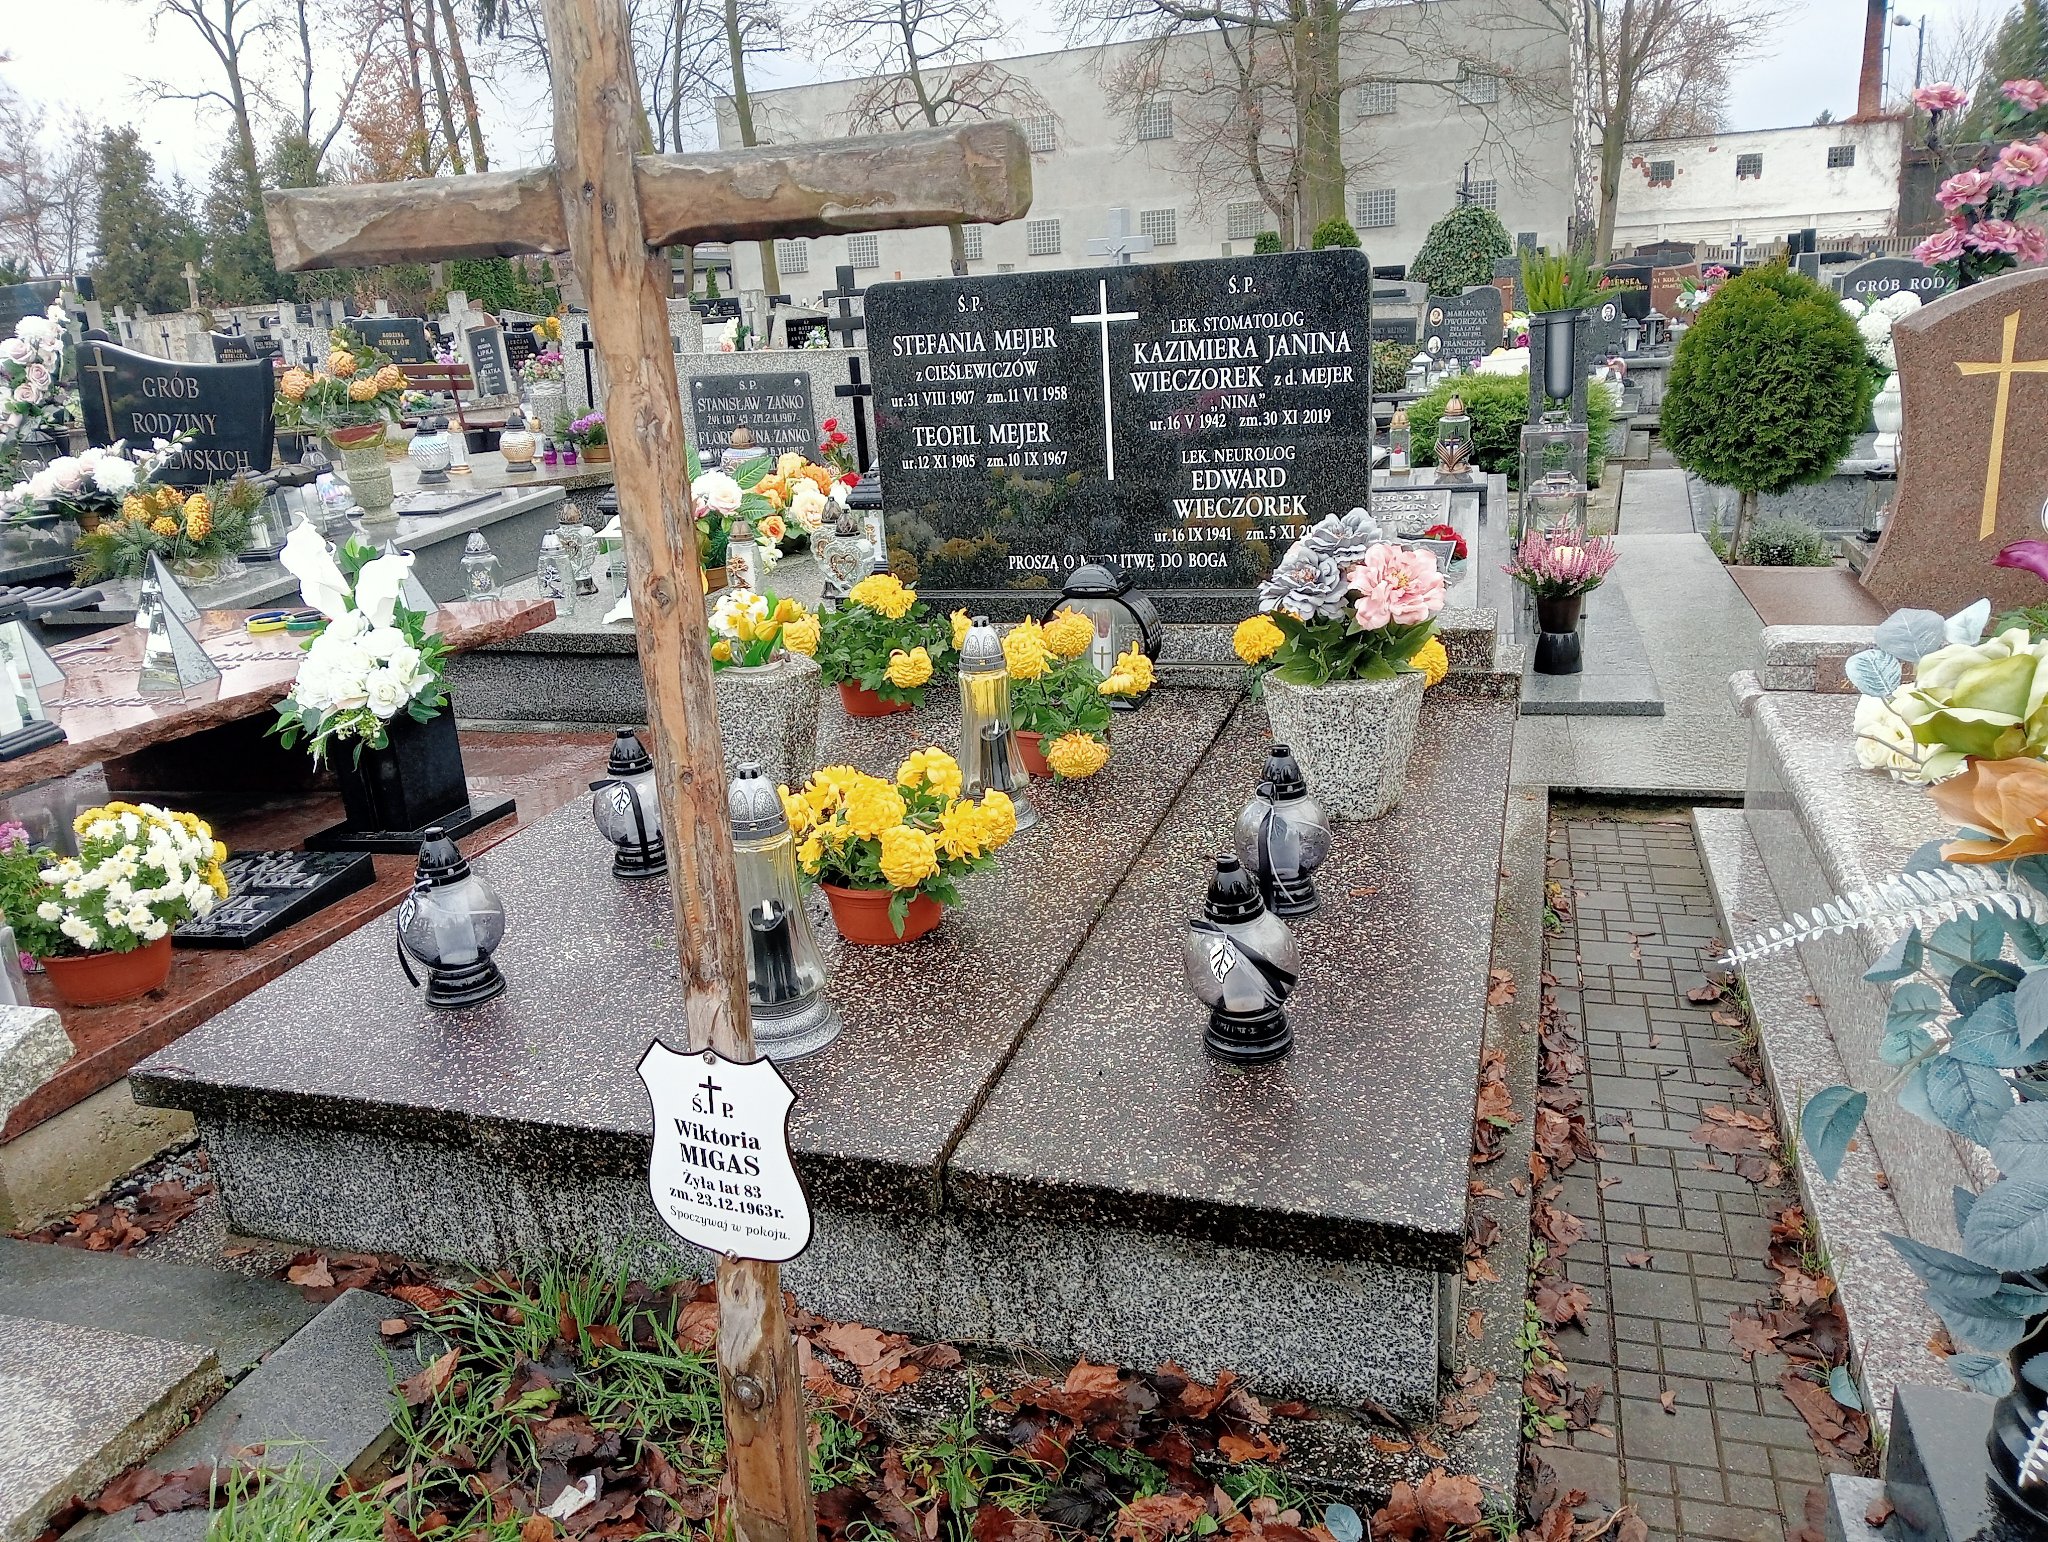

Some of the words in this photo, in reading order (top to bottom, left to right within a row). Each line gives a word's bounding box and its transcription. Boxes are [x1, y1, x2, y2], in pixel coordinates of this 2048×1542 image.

[1856, 276, 1900, 292] GRÓB
[1171, 318, 1201, 334] LEK.
[1203, 311, 1304, 332] STOMATOLOG
[892, 332, 987, 356] STEFANIA
[994, 327, 1058, 355] MEJER
[1133, 336, 1259, 365] KAZIMIERA
[1265, 330, 1352, 364] JANINA
[925, 359, 1039, 381] CIEŚLEWICZÓW
[1129, 366, 1263, 393] WIECZOREK
[1301, 366, 1354, 389] MEJER
[142, 371, 199, 399] GRÓB
[922, 391, 946, 406] VIII
[950, 390, 975, 405] 1907
[1024, 387, 1038, 402] VI
[1042, 386, 1068, 401] 1958
[698, 396, 760, 413] STANISŁAW
[132, 412, 218, 436] RODZINY
[1185, 415, 1196, 429] V
[1199, 413, 1227, 429] 1942
[1283, 410, 1298, 425] XI
[1303, 408, 1331, 424] 2019
[912, 425, 981, 447] TEOFIL
[989, 422, 1051, 449] MEJER
[933, 454, 947, 469] XI
[951, 453, 976, 468] 1905
[1024, 451, 1039, 466] IX
[1042, 451, 1068, 466] 1967
[1182, 448, 1211, 464] LEK.
[1214, 446, 1296, 463] NEUROLOG
[1191, 467, 1287, 491] EDWARD
[1173, 495, 1308, 519] WIECZOREK
[1188, 527, 1203, 541] IX
[1206, 526, 1232, 541] 1941
[1280, 525, 1295, 540] XI
[1008, 554, 1059, 572] PROSZĄ
[1063, 554, 1075, 569] O
[1160, 553, 1182, 568] DO
[1188, 551, 1228, 568] BOGA
[673, 1118, 762, 1150] Wiktoria
[679, 1142, 760, 1176] MIGAS
[669, 1187, 694, 1202] zm.
[683, 1169, 715, 1192] Żyła
[719, 1179, 740, 1196] lat
[744, 1185, 762, 1199] 83
[670, 1205, 729, 1231] Spoczywaj
[731, 1222, 742, 1233] w
[745, 1225, 791, 1241] pokoju.
